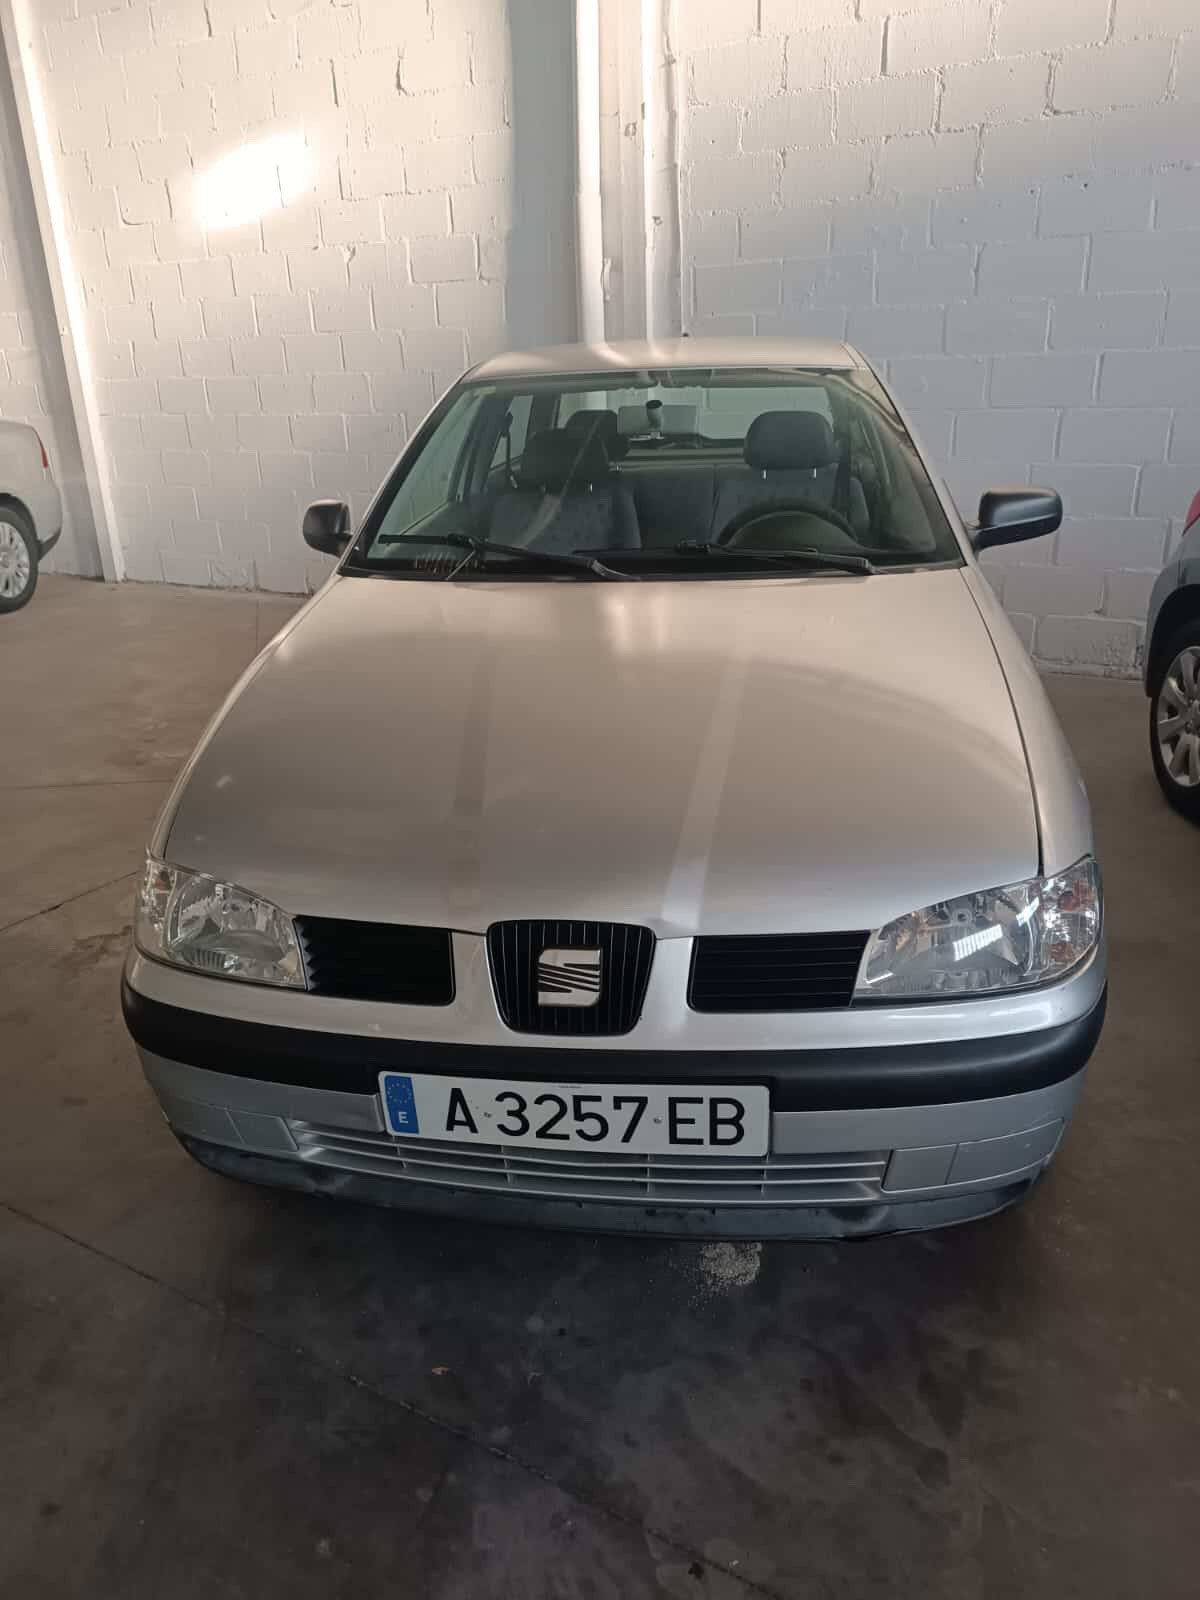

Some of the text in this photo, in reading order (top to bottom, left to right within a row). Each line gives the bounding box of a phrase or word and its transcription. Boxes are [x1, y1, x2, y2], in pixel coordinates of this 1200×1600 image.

[398, 1111, 409, 1124] E
[445, 1087, 746, 1146] A 3257 EB
